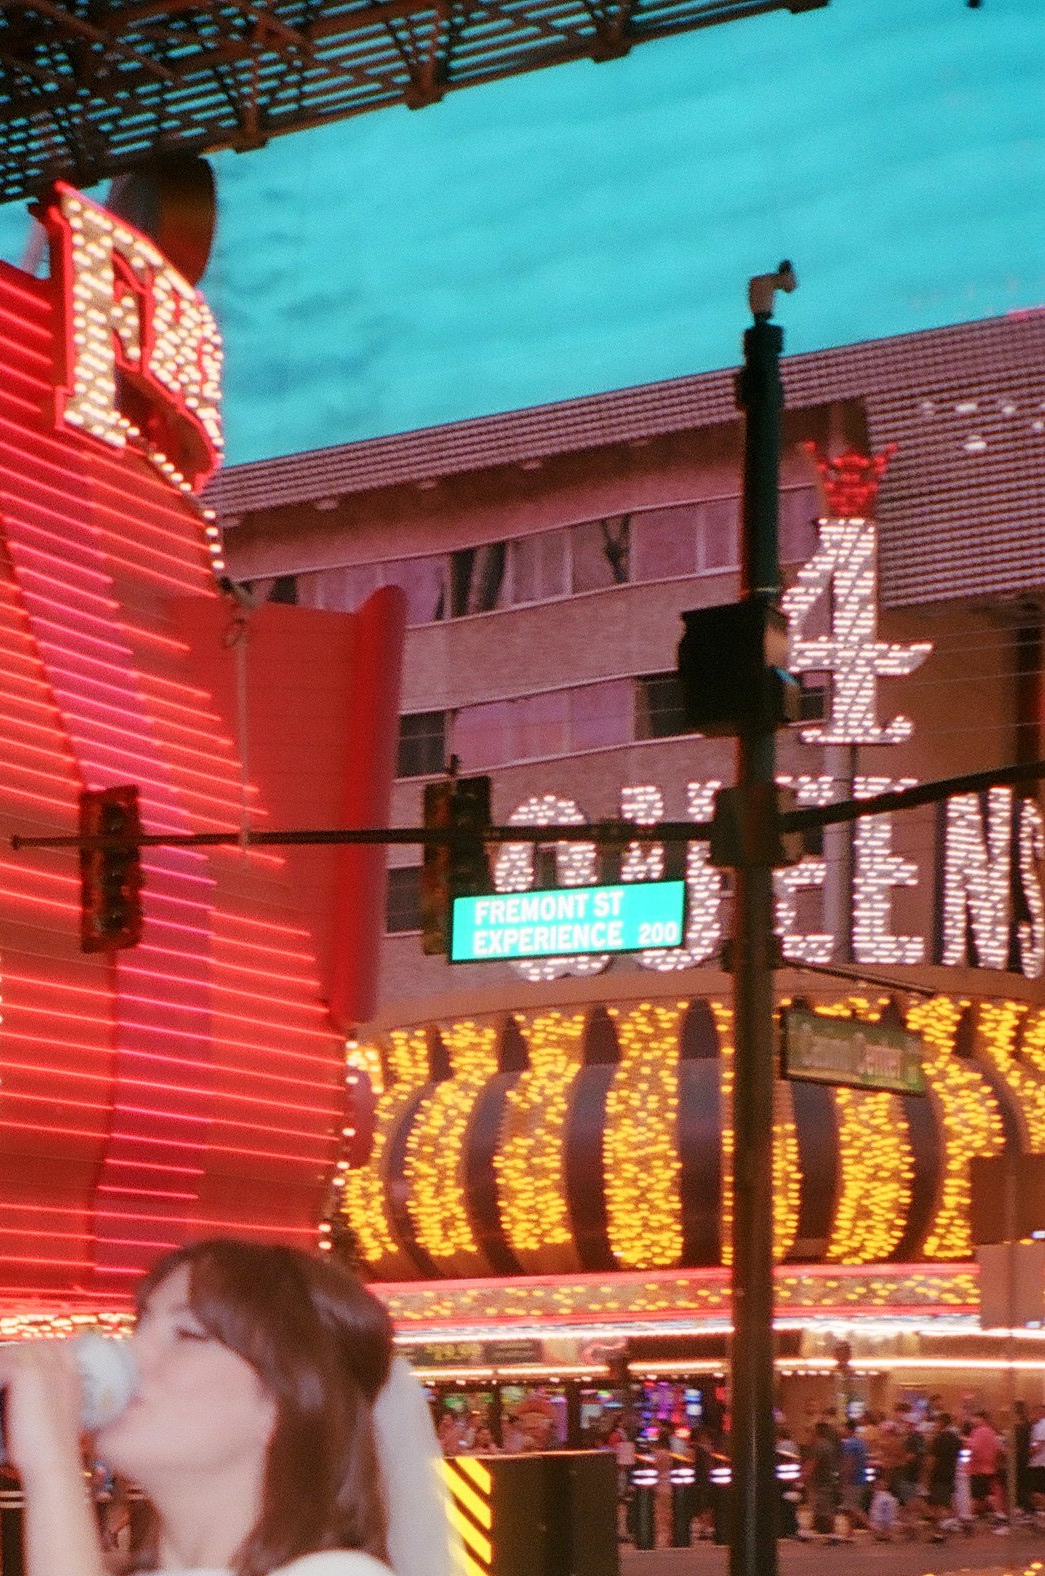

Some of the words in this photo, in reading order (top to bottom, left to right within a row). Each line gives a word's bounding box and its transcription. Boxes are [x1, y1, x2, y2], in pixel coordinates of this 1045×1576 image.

[474, 893, 589, 926] FREMONT
[593, 890, 625, 916] ST
[472, 920, 624, 956] EXPERIENCE
[638, 920, 678, 946] 200
